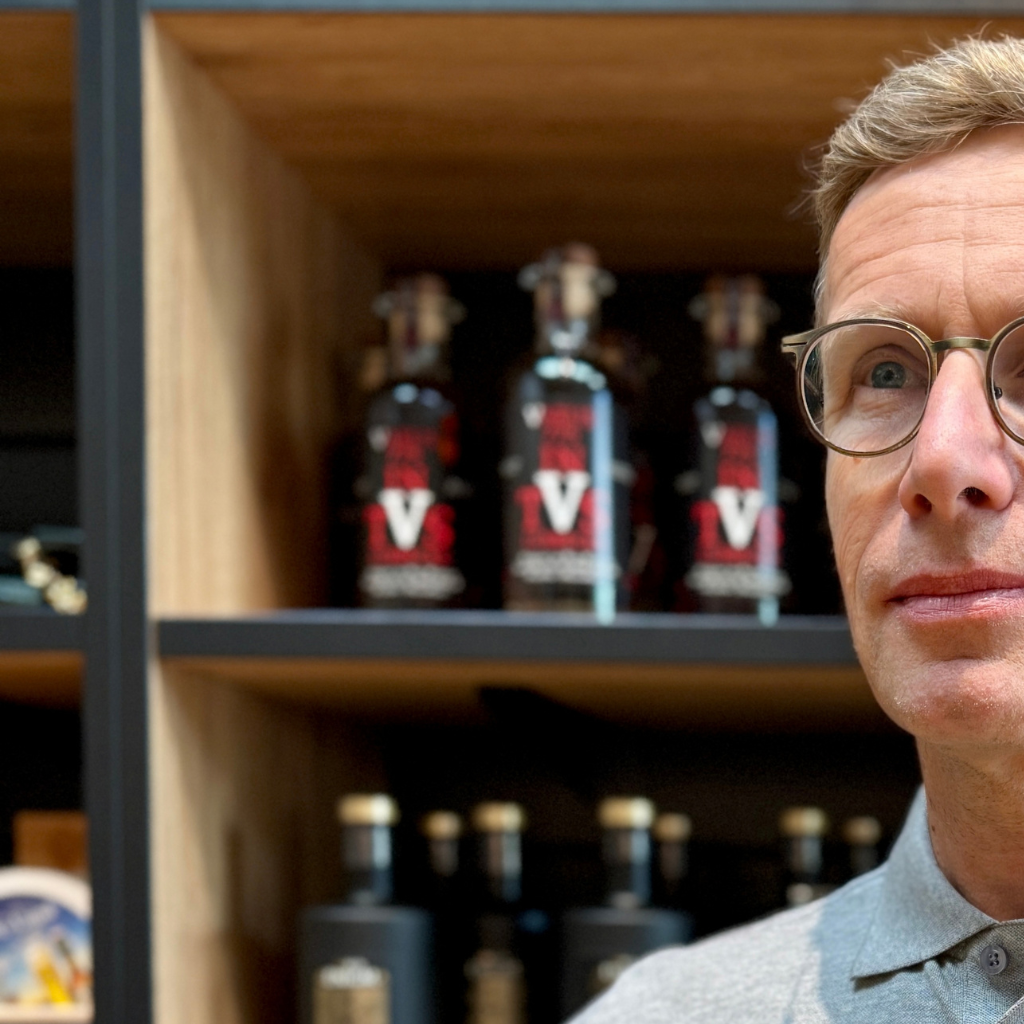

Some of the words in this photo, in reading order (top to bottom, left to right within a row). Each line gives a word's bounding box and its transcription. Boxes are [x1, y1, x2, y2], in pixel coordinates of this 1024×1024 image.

[378, 487, 436, 552] V
[532, 469, 591, 535] V
[711, 486, 765, 551] V
